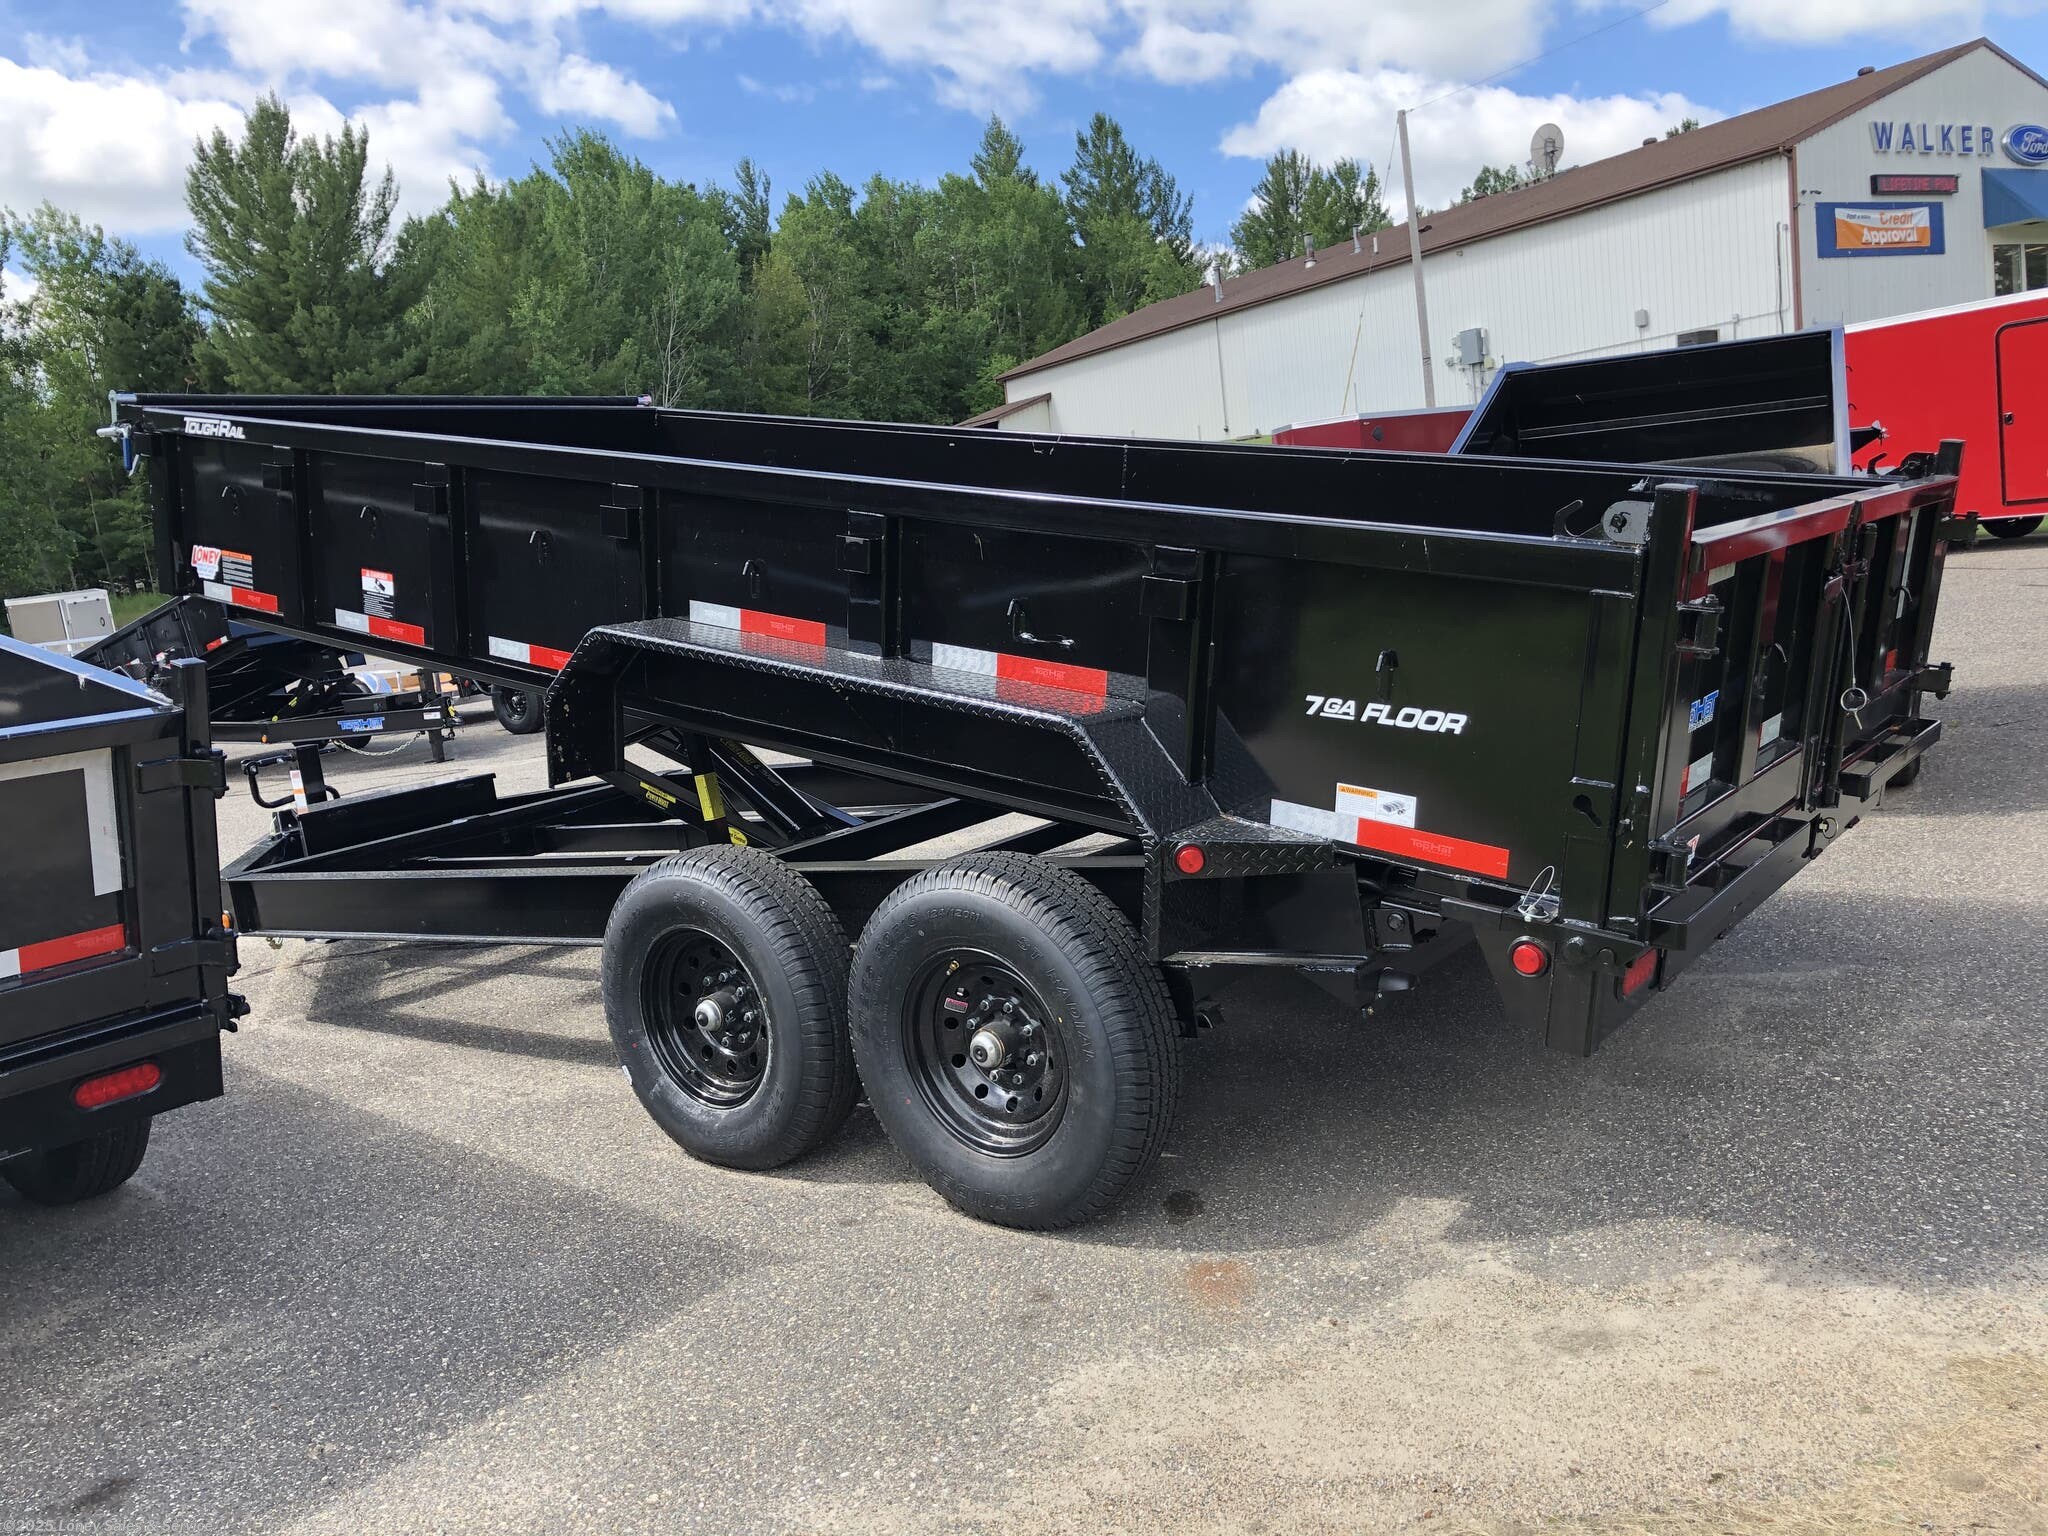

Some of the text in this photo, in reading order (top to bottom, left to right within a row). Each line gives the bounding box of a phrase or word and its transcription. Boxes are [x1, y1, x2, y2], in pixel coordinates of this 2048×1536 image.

[1871, 121, 1994, 155] WALKER
[1879, 211, 1914, 225] Credit
[1862, 226, 1917, 246] Approval
[192, 546, 220, 565] LONEY
[1360, 703, 1467, 735] FLOOR
[1345, 786, 1374, 798] WARNING
